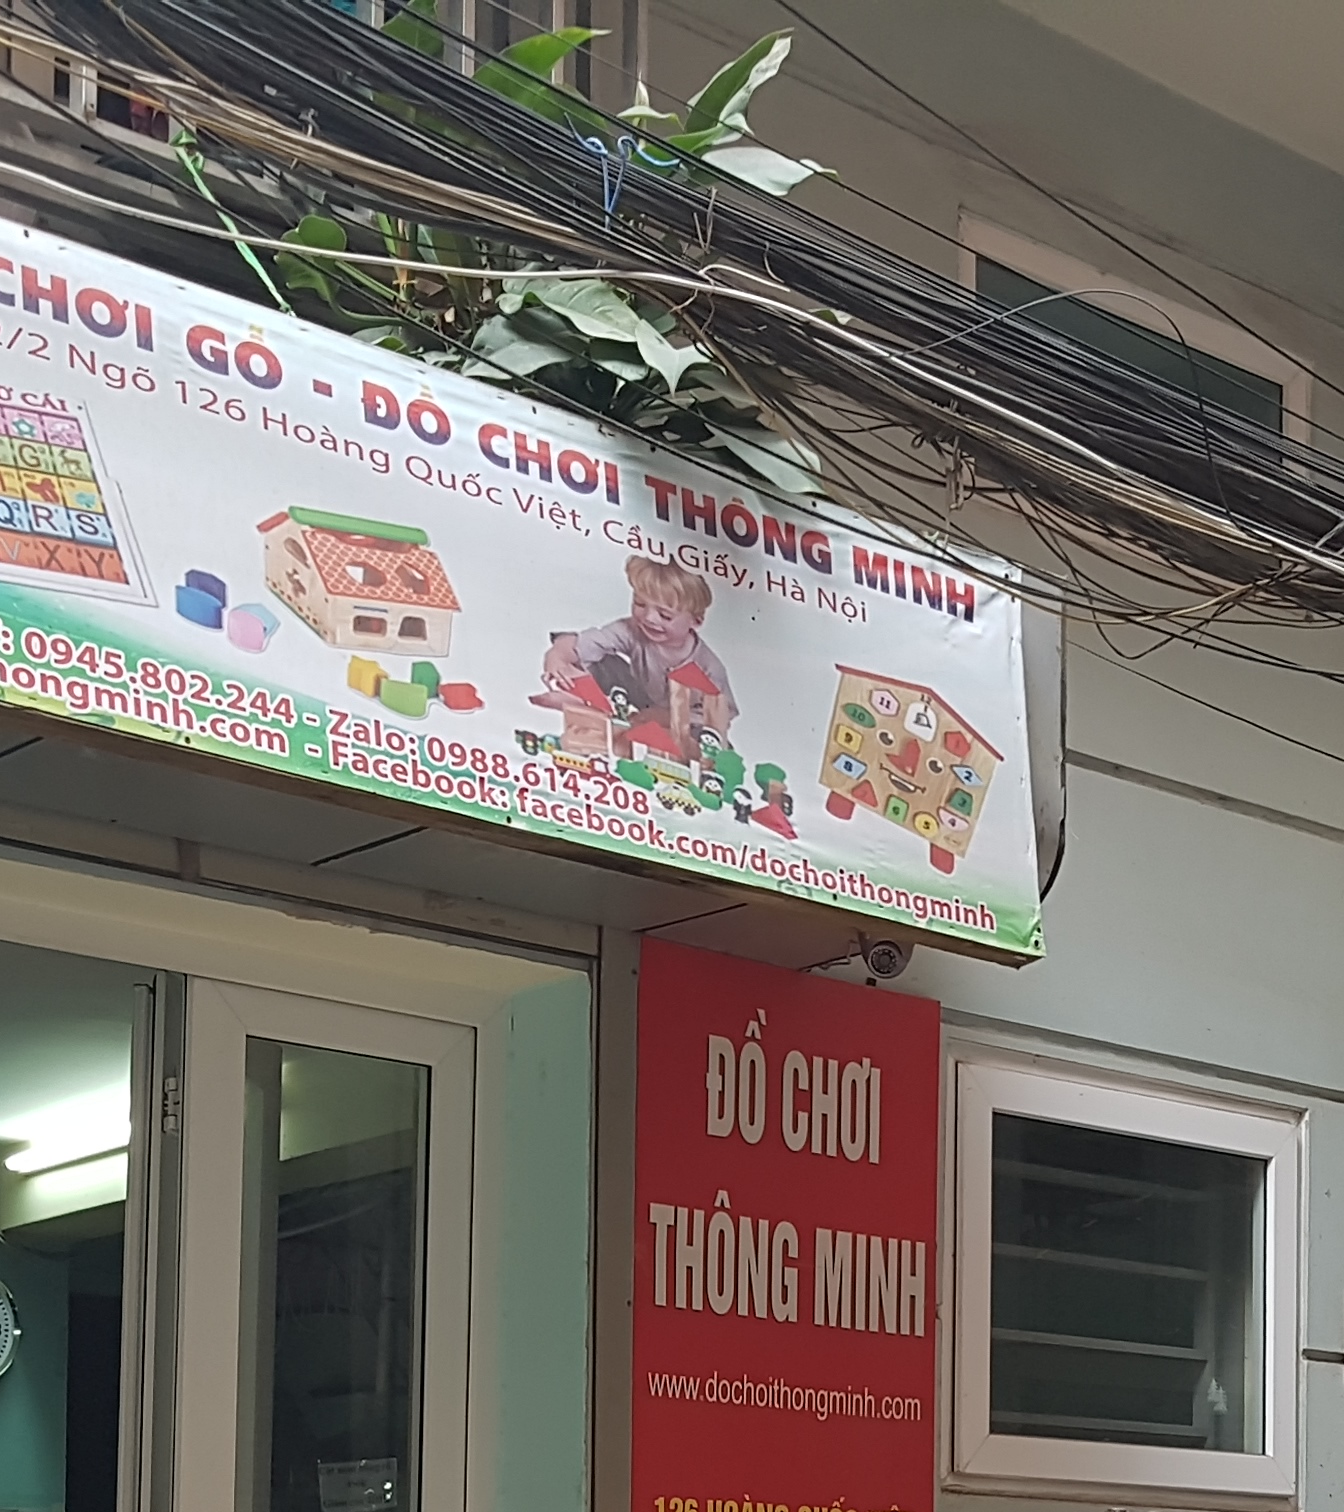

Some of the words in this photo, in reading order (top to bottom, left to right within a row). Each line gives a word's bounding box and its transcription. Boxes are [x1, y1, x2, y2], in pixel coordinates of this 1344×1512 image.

[20, 393, 69, 413] CÁI
[68, 342, 156, 393] Ngõ
[174, 380, 247, 422] 126
[262, 406, 390, 474] Hoàng
[406, 455, 504, 506] Quốc
[512, 487, 591, 537] Việt,
[678, 544, 754, 590] Giấy,
[767, 570, 806, 603] Hà
[818, 587, 867, 623] Nội
[186, 324, 283, 390] GỖ
[361, 380, 451, 446] ĐỒ
[478, 423, 620, 506] CHƠI
[645, 475, 833, 574] THÔNG
[852, 546, 975, 622] MINH
[24, 629, 296, 726] 0945.802.244
[329, 708, 417, 756] Zalo:
[427, 736, 650, 815] 0988.614.208
[331, 739, 508, 809] Facebook:
[518, 786, 997, 933] facebook.com/dochoithongminh
[706, 1008, 767, 1144] ĐỒ
[782, 1050, 881, 1164] CHƠI
[649, 1190, 799, 1323] THÔNG
[813, 1227, 926, 1338] MINH
[647, 1371, 922, 1421] www.dochoithongminh.com
